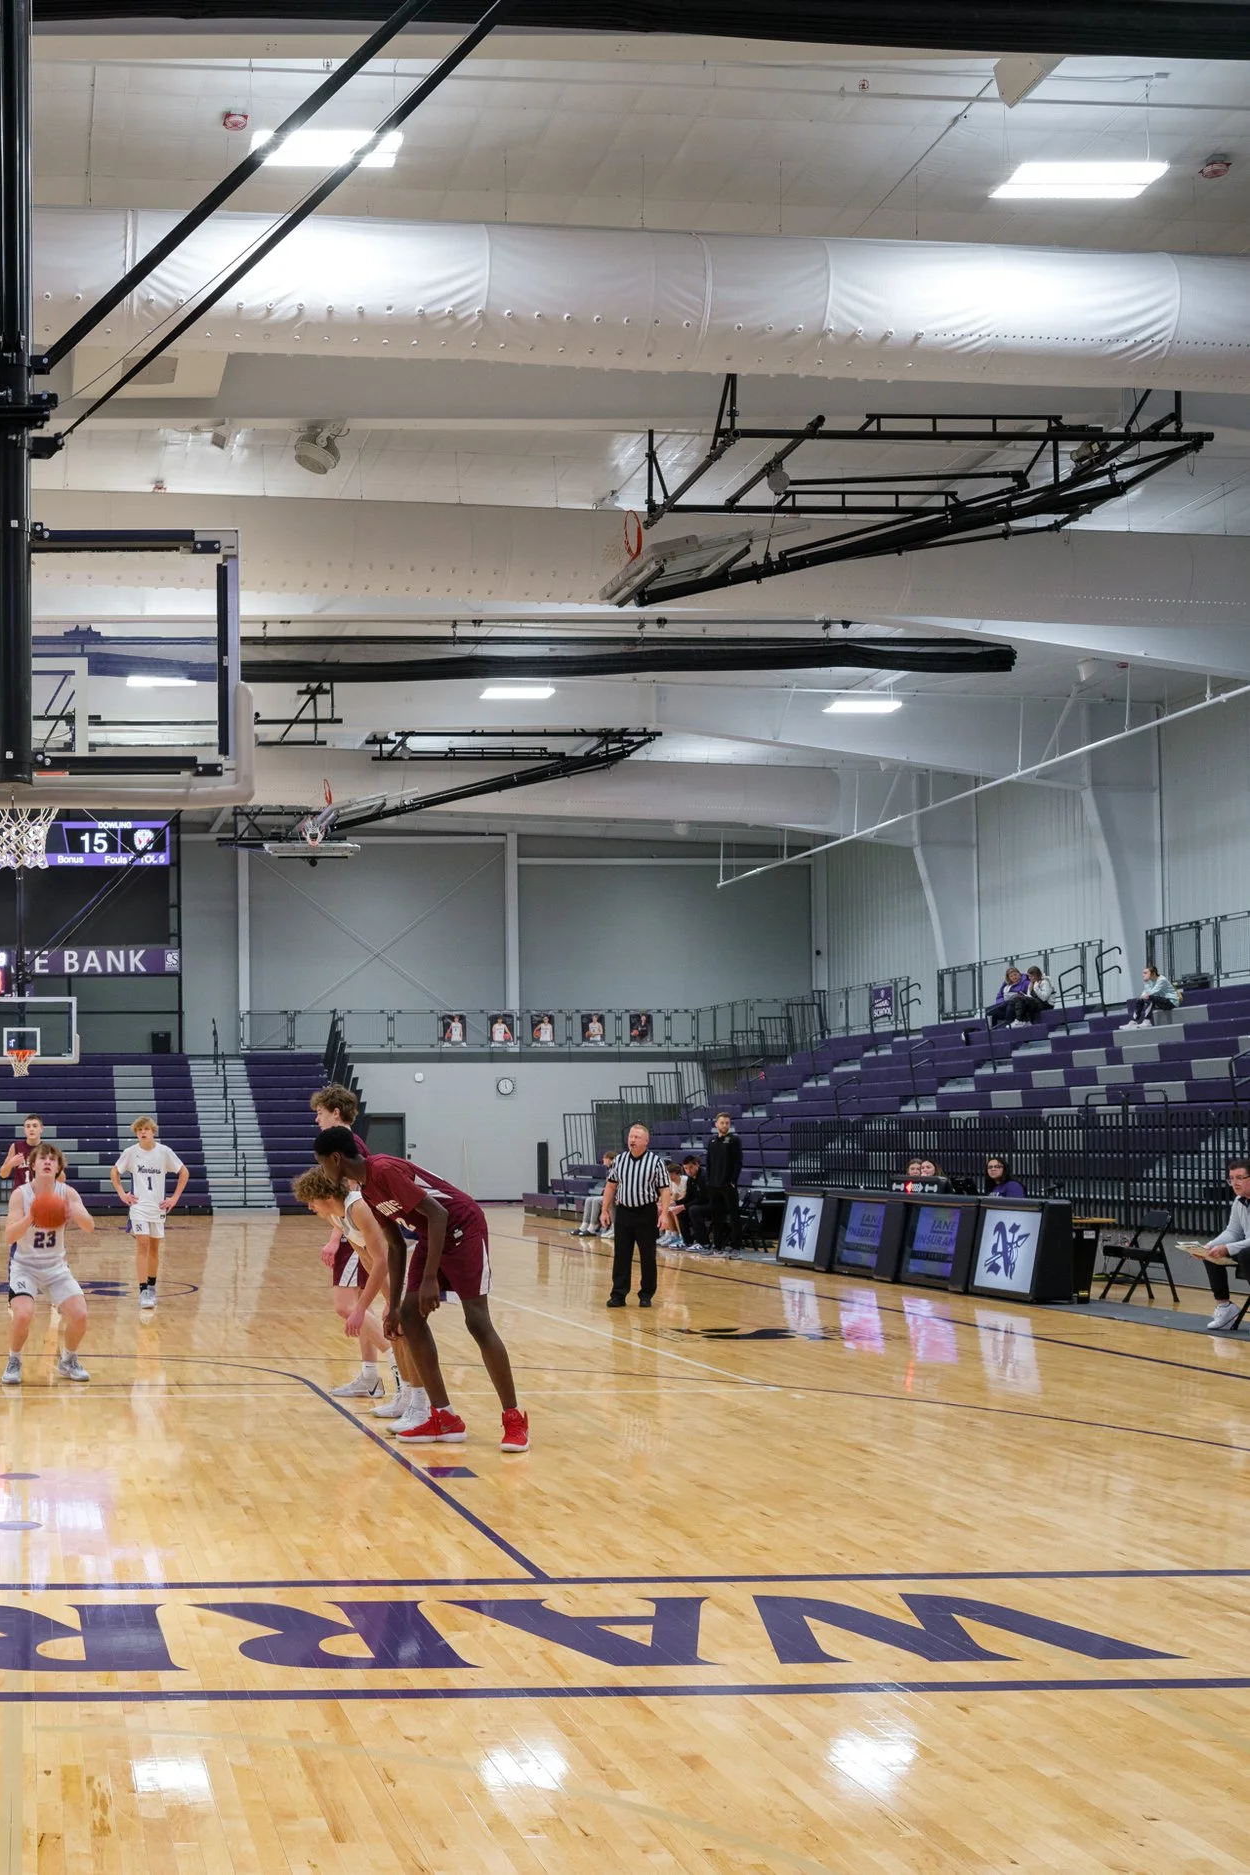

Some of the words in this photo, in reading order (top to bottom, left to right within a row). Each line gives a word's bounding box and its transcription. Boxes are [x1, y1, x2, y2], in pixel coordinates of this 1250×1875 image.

[80, 832, 108, 853] 15
[57, 855, 84, 864] Bonus
[104, 855, 127, 864] Fouls
[64, 950, 147, 973] BANK
[137, 1165, 161, 1174] Warriors
[147, 1176, 153, 1191] 1
[33, 1231, 57, 1249] 23
